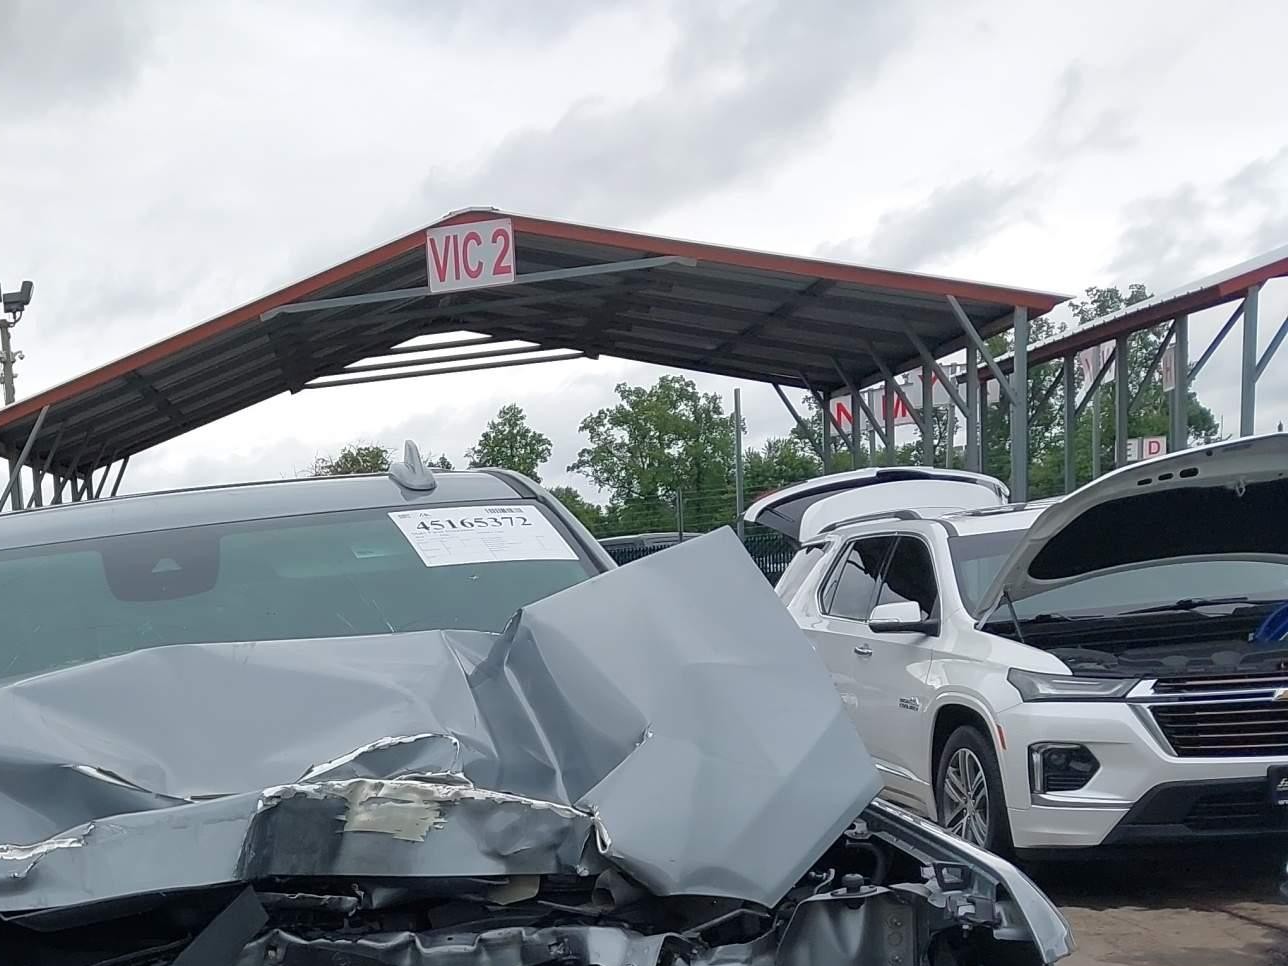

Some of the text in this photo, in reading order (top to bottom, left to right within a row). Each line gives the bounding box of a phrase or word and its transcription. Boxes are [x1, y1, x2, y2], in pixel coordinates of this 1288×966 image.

[428, 228, 513, 283] VIC 2
[1148, 440, 1161, 455] D
[416, 516, 533, 532] 45165372
